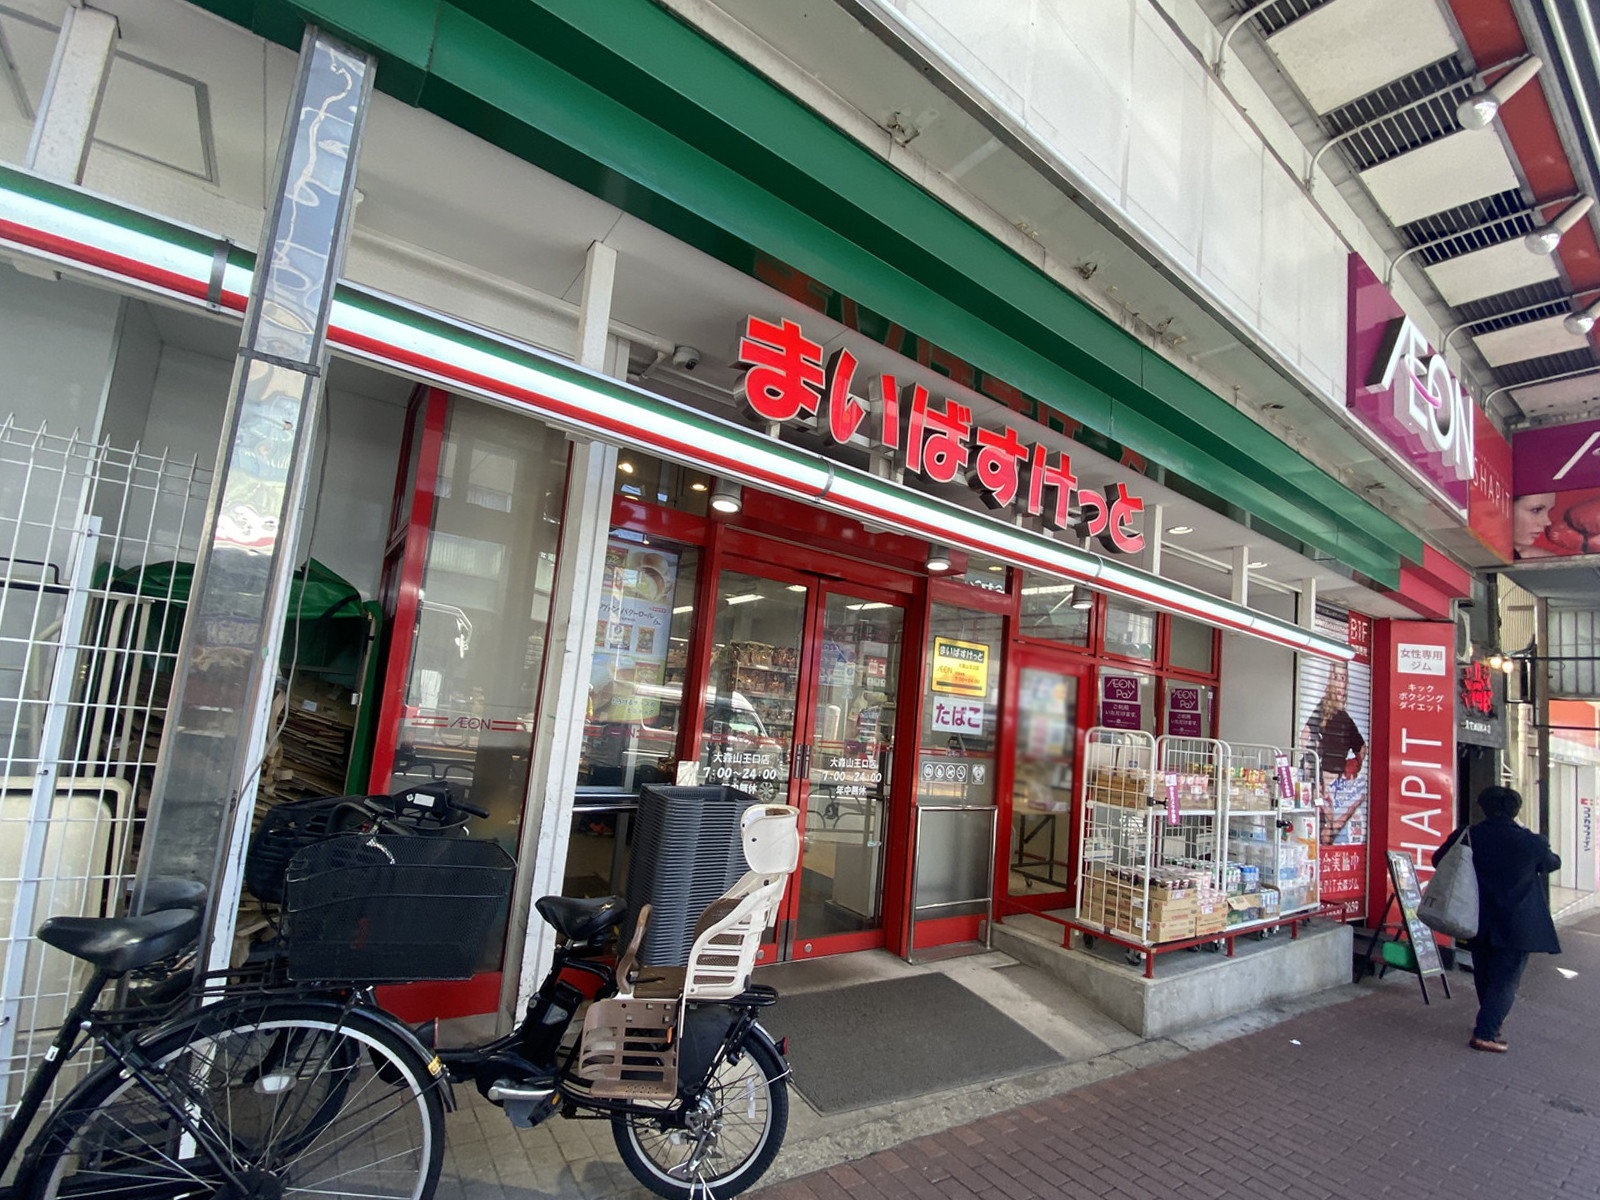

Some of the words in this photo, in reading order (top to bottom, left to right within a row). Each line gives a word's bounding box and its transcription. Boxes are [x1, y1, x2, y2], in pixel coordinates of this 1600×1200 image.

[737, 314, 1146, 554] まいばすけっと
[939, 644, 983, 662] まいばすけっと
[1400, 648, 1443, 661] 女性専用
[1411, 660, 1432, 671] ジム
[1115, 689, 1135, 699] Pay
[1408, 683, 1434, 693] キック
[1398, 692, 1444, 703] ボクシング
[1179, 700, 1196, 709] Pay
[1399, 702, 1443, 713] ダイエット
[935, 703, 981, 728] たばこ
[713, 752, 770, 765] 大森山王口店
[1401, 728, 1443, 893] HAPIT
[1319, 851, 1360, 873] 会実施中
